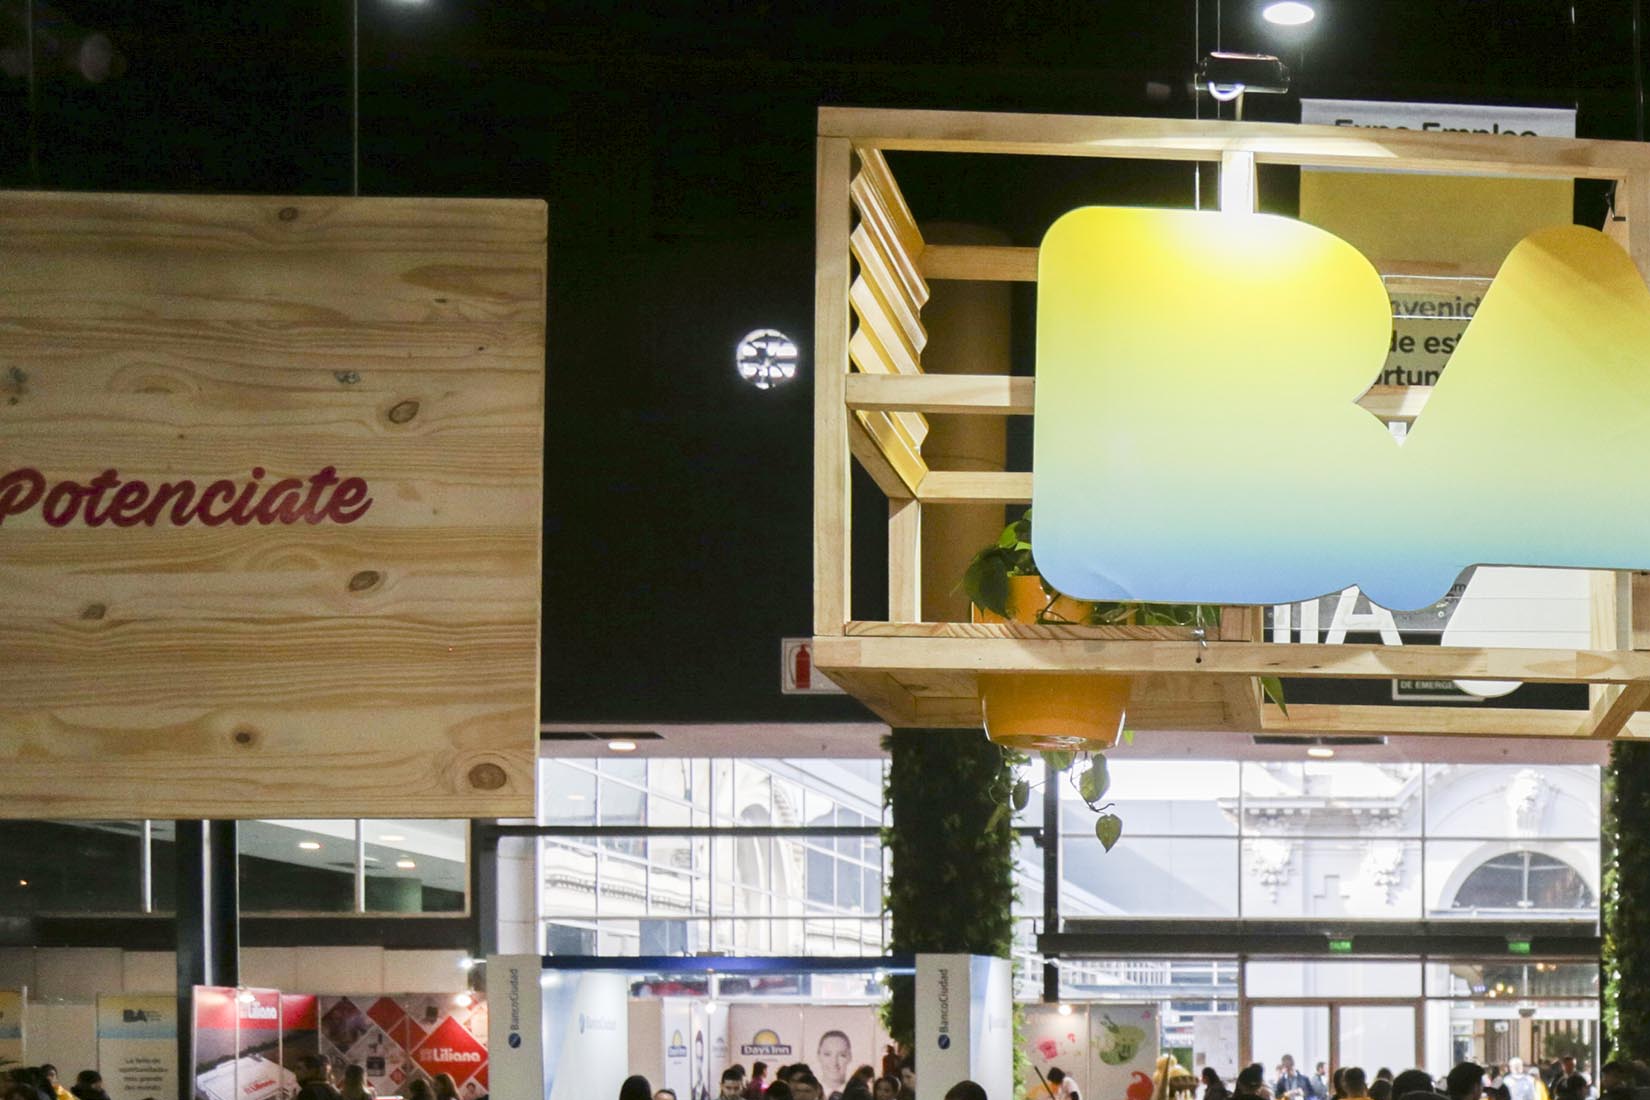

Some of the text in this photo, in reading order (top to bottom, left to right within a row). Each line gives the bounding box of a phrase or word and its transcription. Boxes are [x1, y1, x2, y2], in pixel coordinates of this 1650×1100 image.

[510, 968, 520, 1031] BancoCiudad
[938, 968, 949, 1033] BancoCiudad
[433, 1048, 481, 1062] Liliana
